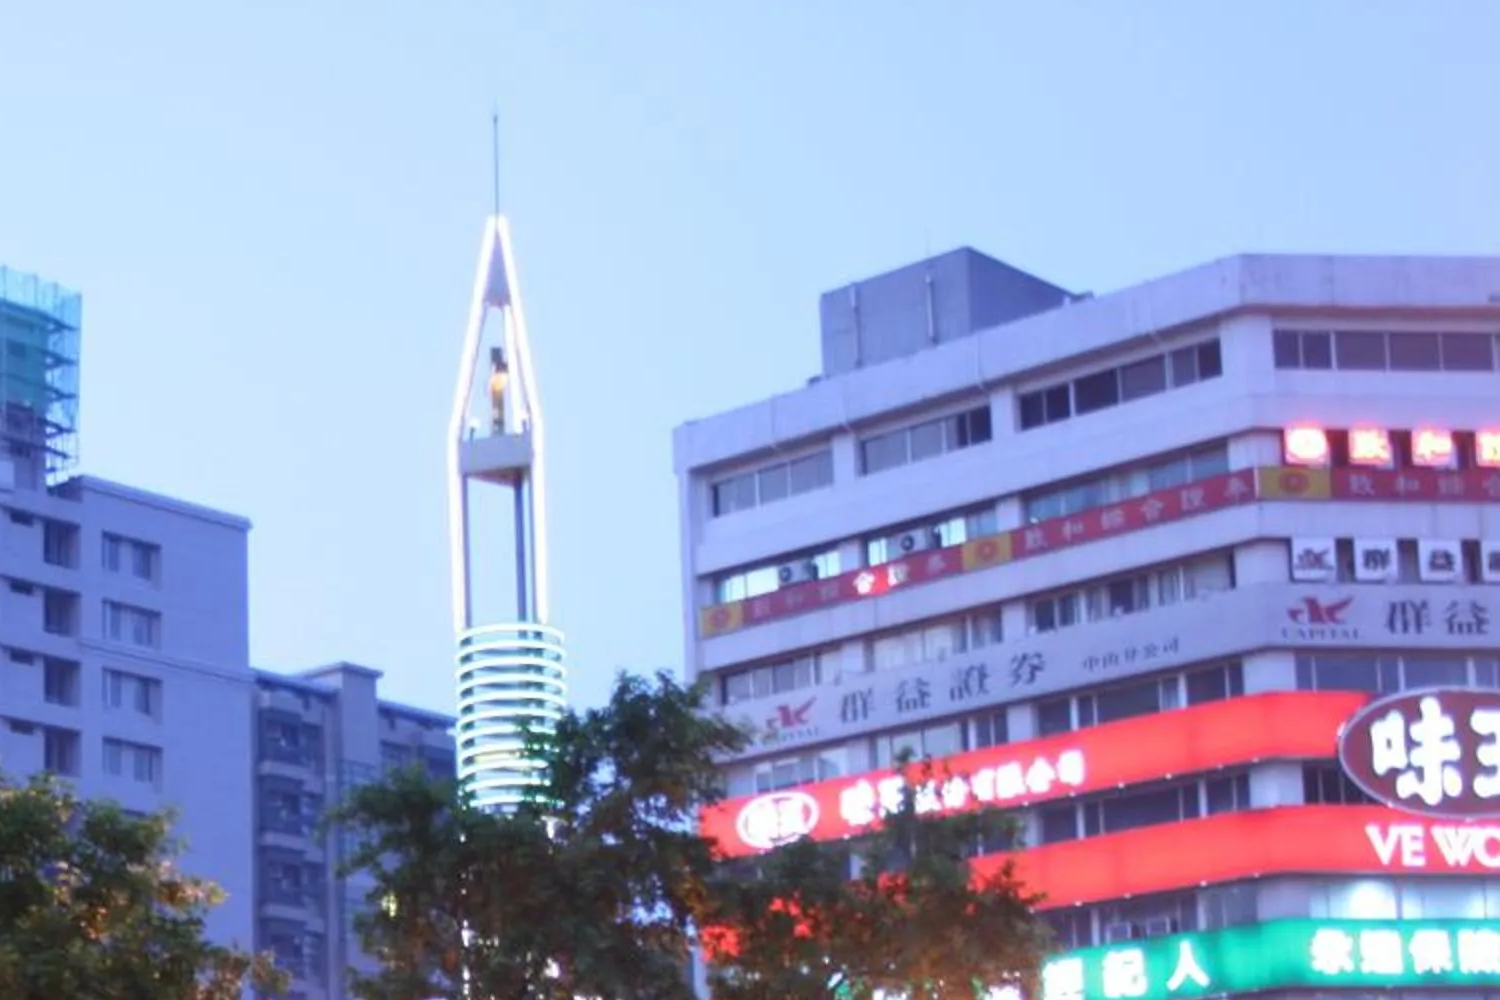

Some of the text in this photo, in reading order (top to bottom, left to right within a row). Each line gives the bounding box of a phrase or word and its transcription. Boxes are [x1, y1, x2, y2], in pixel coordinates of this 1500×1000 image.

[1281, 627, 1359, 641] CAPITAL
[840, 651, 1047, 725] 群益證券
[1365, 824, 1426, 868] VE
